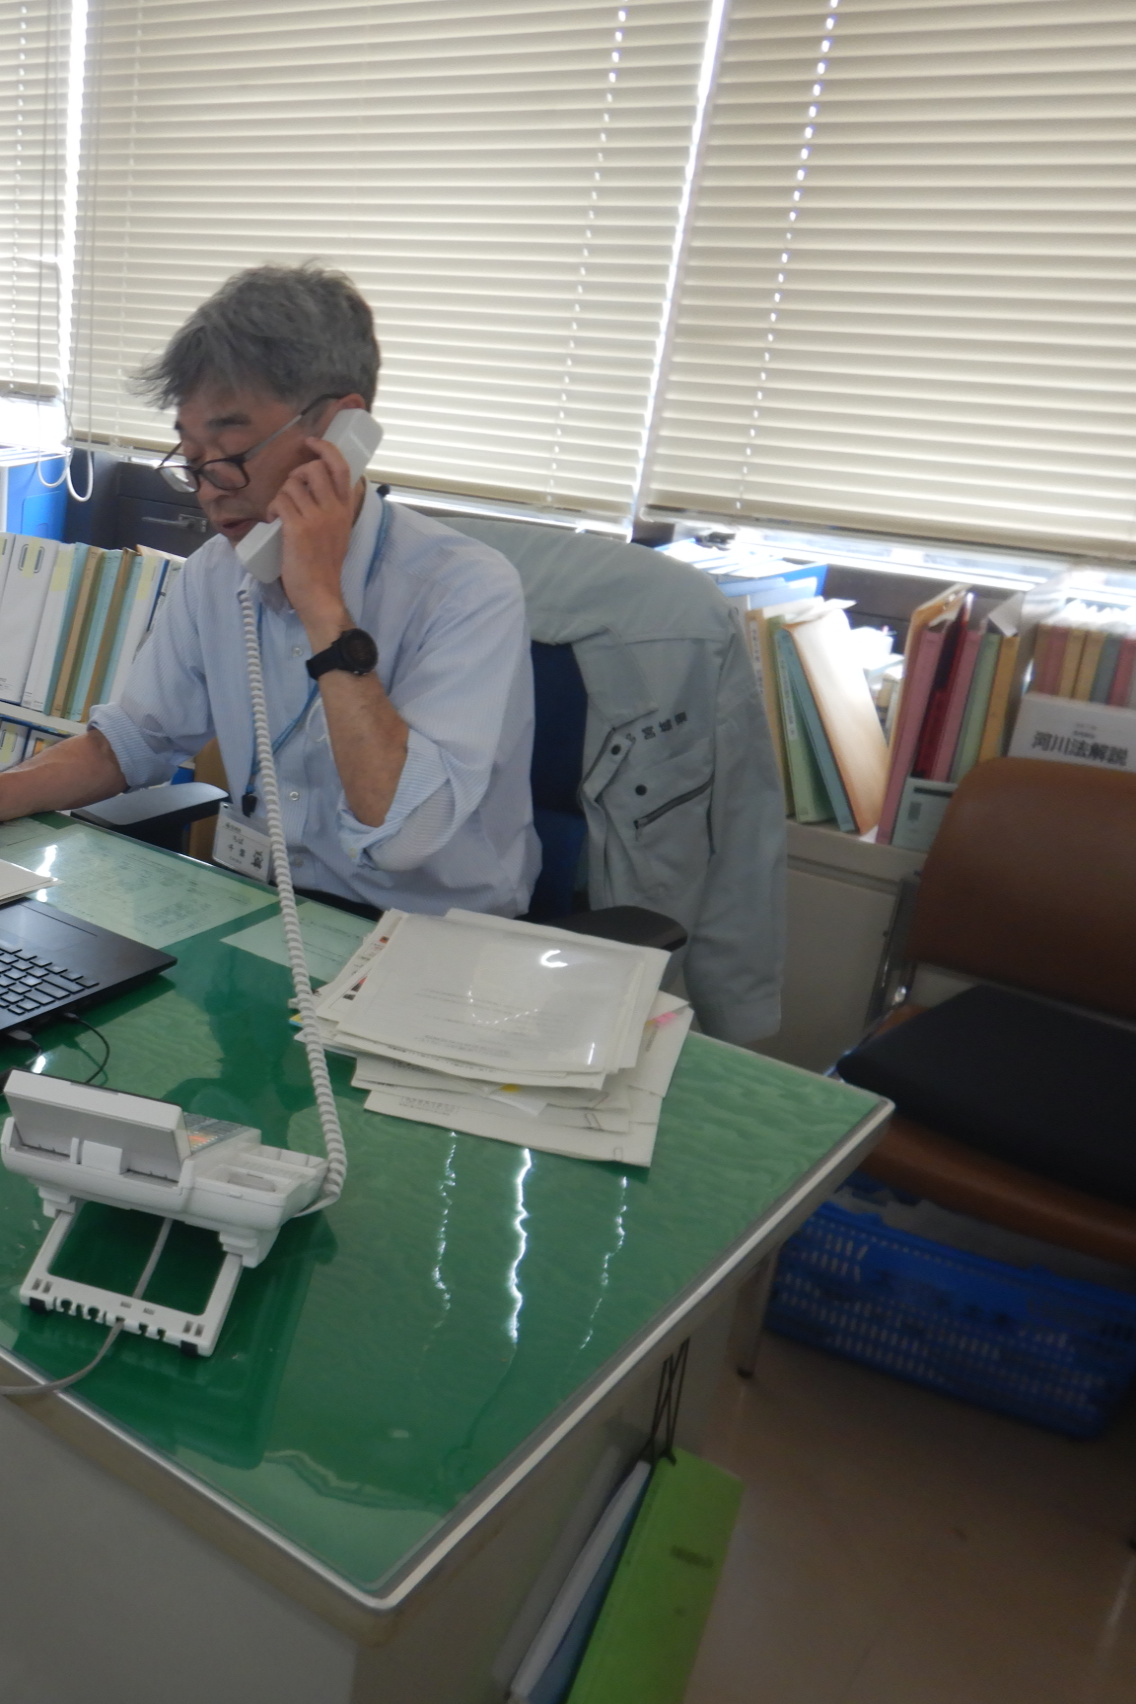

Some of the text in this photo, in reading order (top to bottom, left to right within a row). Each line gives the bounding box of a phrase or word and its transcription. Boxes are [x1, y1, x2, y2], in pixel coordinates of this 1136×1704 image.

[1031, 730, 1128, 766] 河川法解説
